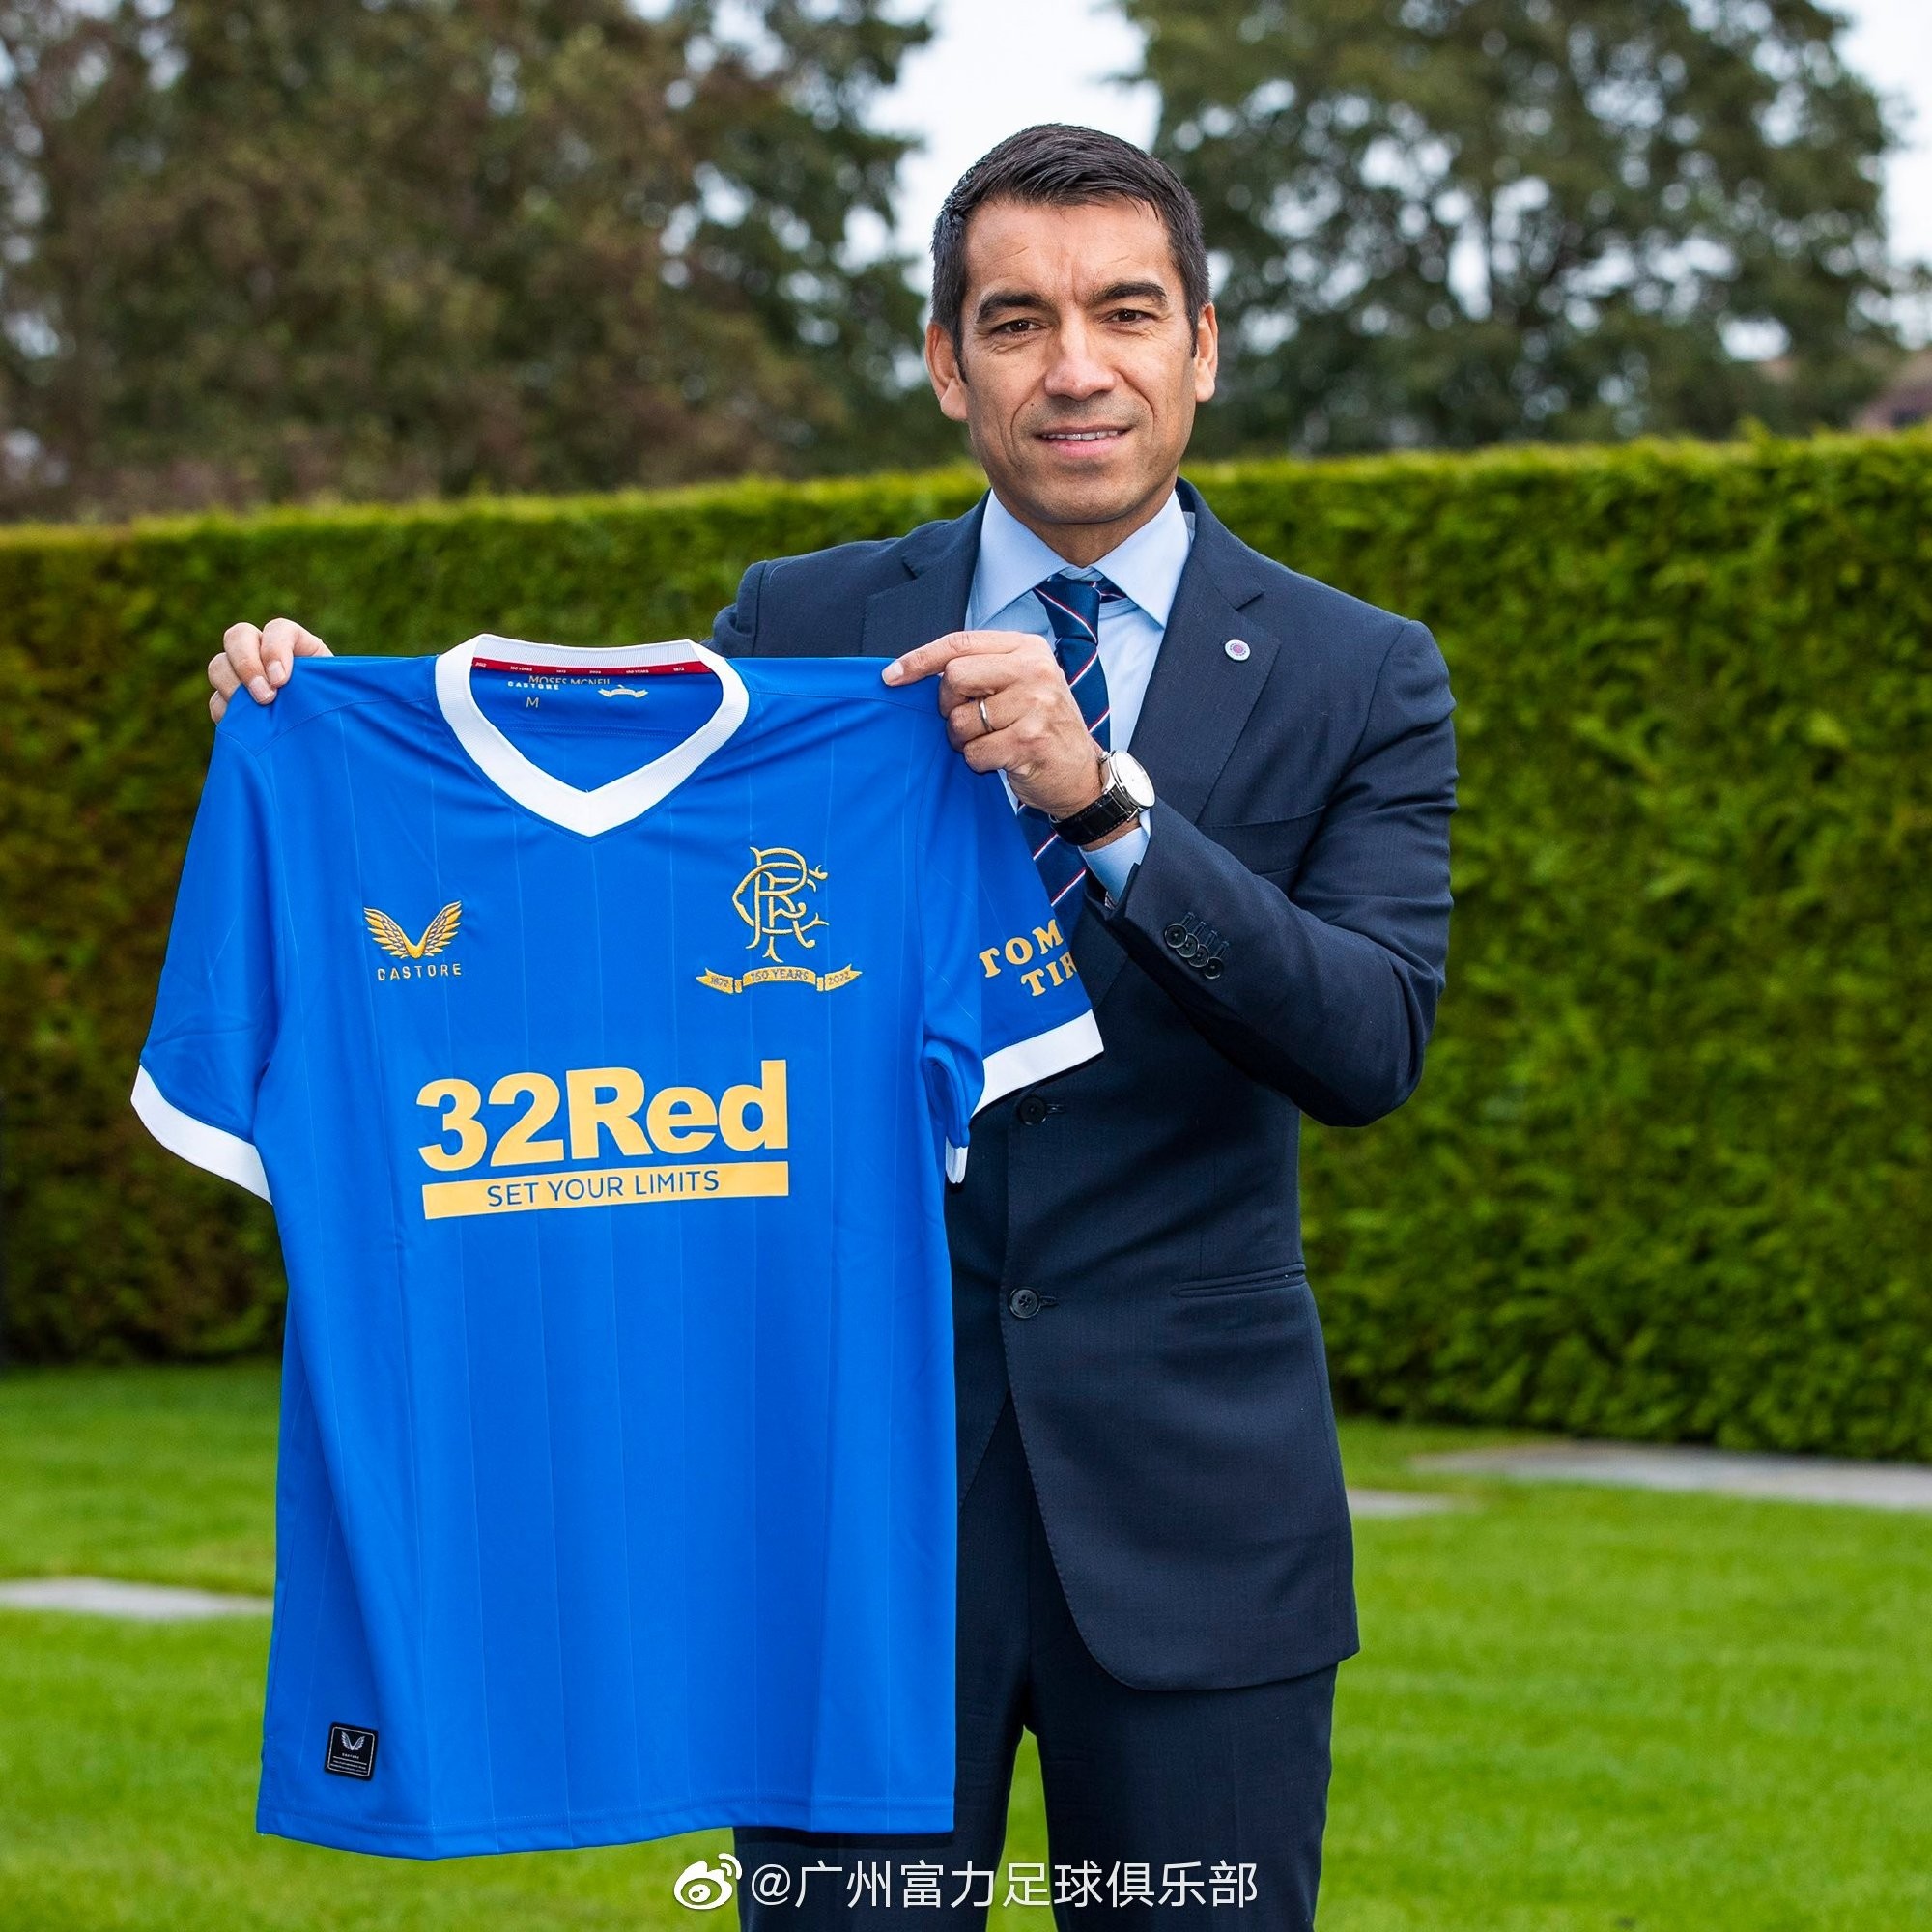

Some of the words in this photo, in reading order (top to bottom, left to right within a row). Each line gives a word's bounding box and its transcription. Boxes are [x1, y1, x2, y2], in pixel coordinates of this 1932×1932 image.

[507, 681, 559, 690] CASTORE
[526, 696, 540, 708] M
[377, 963, 462, 981] CASTORE
[750, 969, 769, 981] 150
[773, 968, 809, 980] YEARS
[828, 972, 851, 985] 2022
[416, 1059, 788, 1171] 32Red
[487, 1182, 539, 1207] SET
[548, 1176, 623, 1201] YOUR
[635, 1170, 720, 1195] LIMITS
